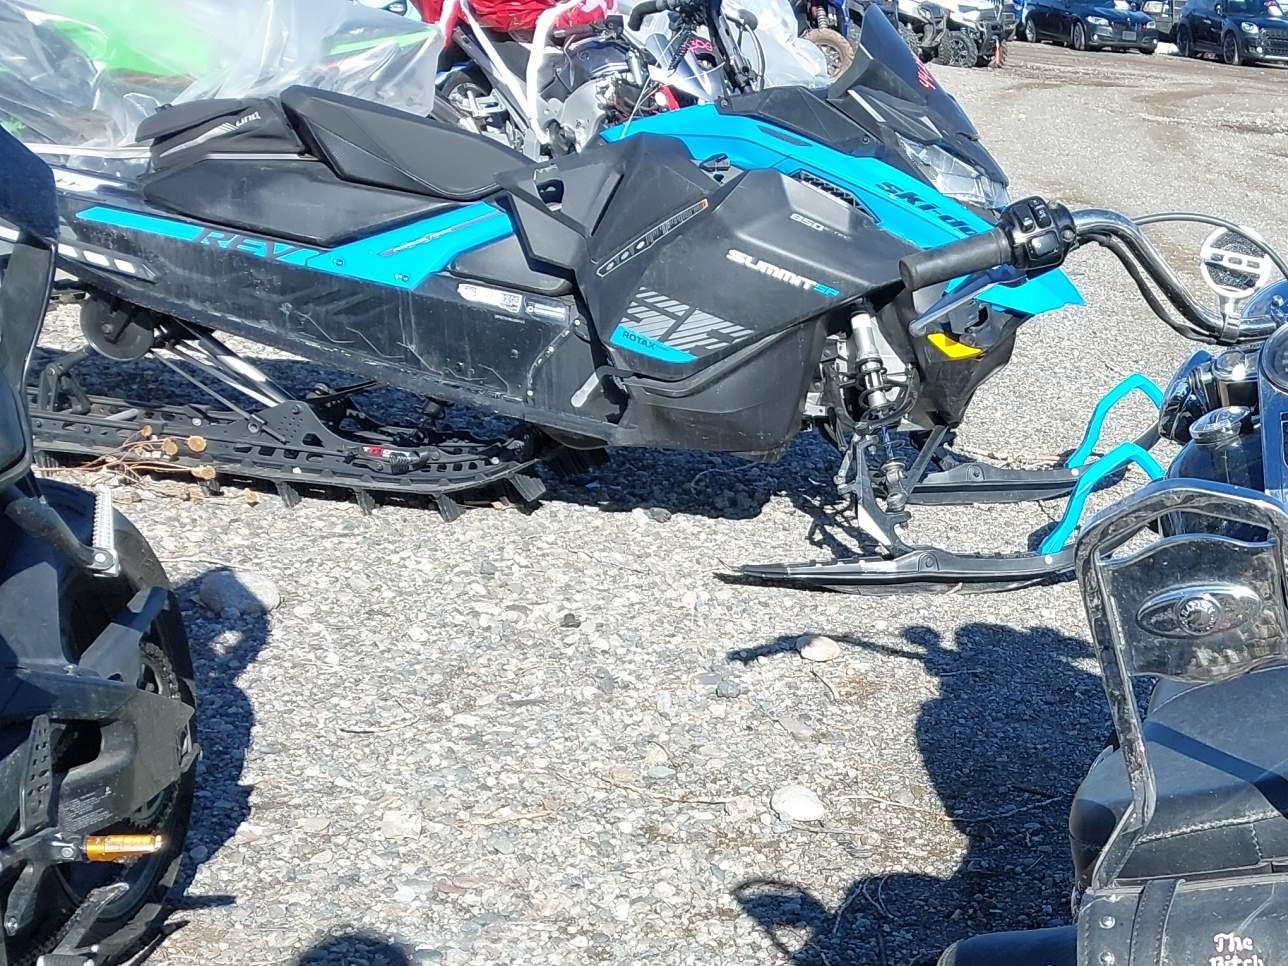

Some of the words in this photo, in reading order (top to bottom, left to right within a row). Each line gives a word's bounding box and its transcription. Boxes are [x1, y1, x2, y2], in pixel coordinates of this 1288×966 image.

[790, 213, 825, 231] 850
[725, 249, 818, 291] SUMMIT
[622, 330, 656, 350] ROTAX
[1213, 932, 1254, 952] The
